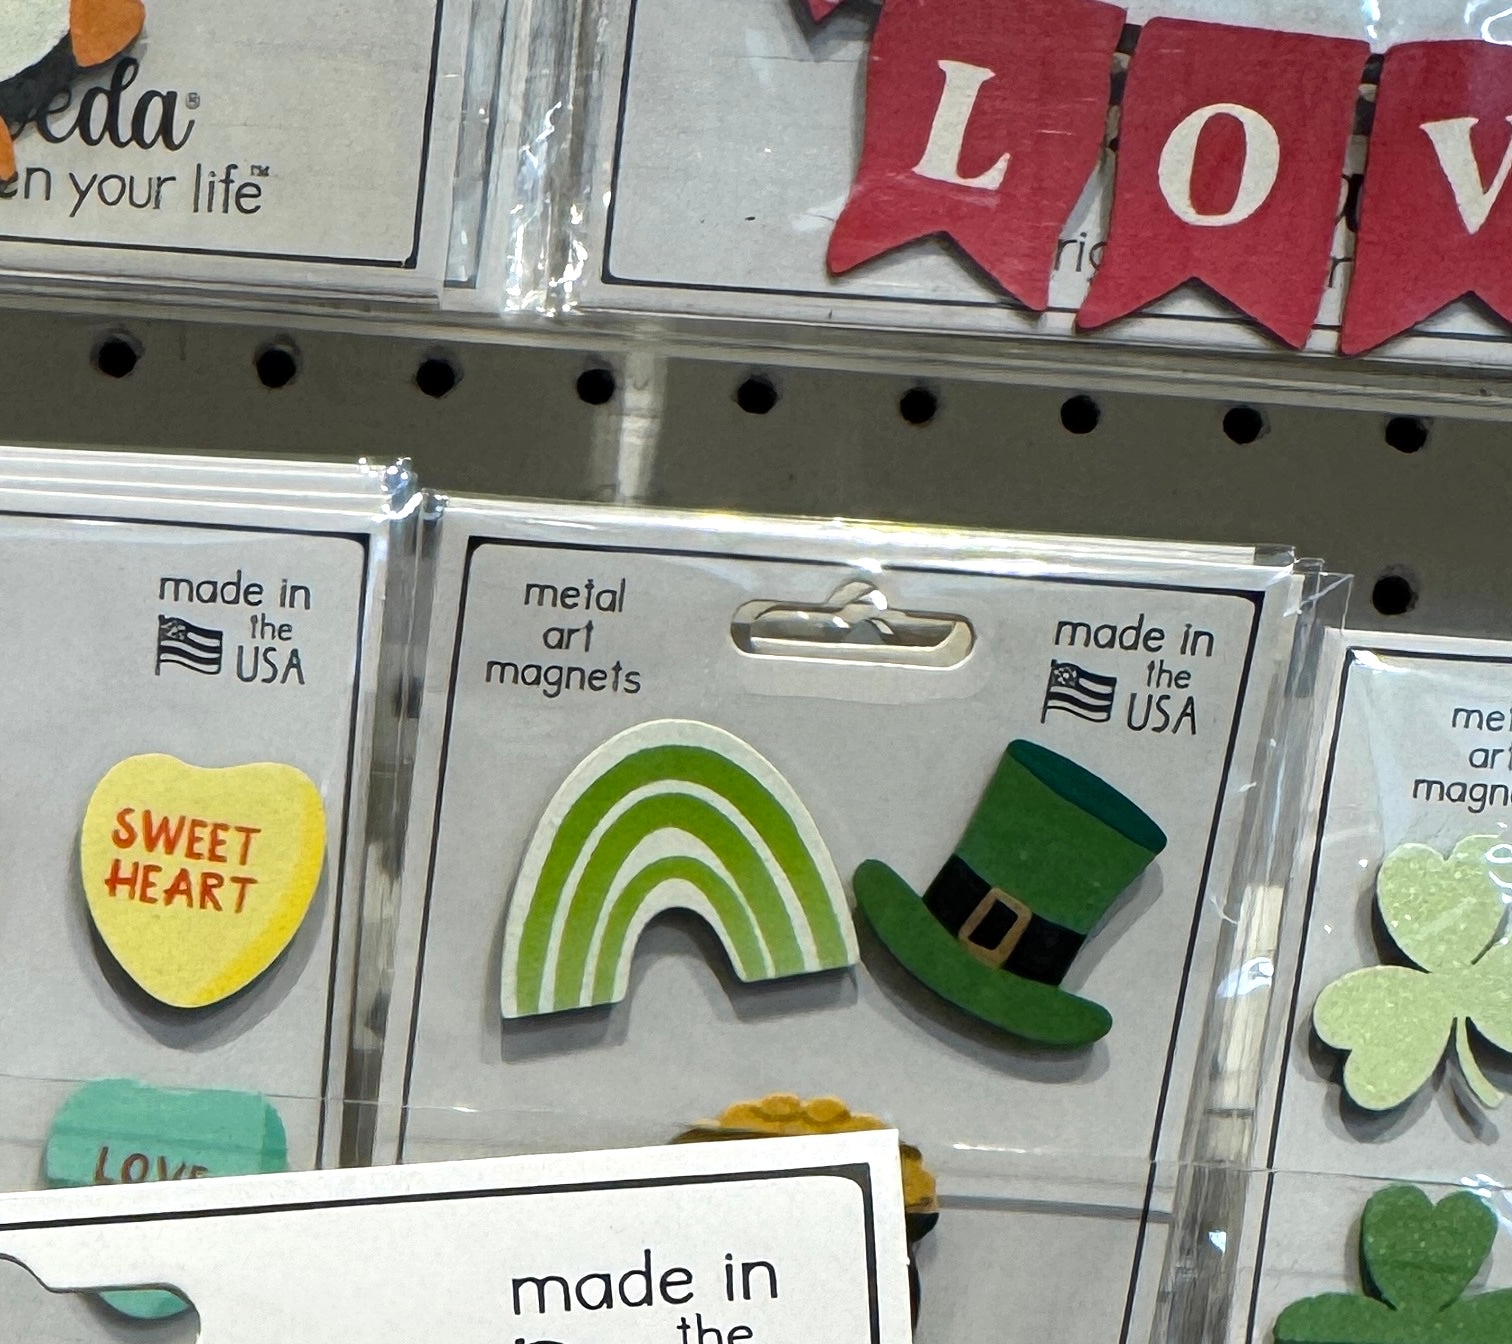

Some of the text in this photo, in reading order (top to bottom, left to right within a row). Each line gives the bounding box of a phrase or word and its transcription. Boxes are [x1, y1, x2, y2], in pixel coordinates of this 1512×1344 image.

[68, 172, 176, 218] your
[158, 570, 311, 609] made in
[523, 577, 627, 613] metal
[250, 613, 293, 641] the
[541, 619, 594, 653] art
[1054, 614, 1215, 658] made in
[235, 645, 306, 685] USA
[485, 658, 642, 698] magnets
[1146, 657, 1193, 690] the
[1125, 693, 1198, 736] USA
[111, 807, 262, 866] SWEET
[104, 858, 258, 914] HEART
[511, 1248, 778, 1315] made in
